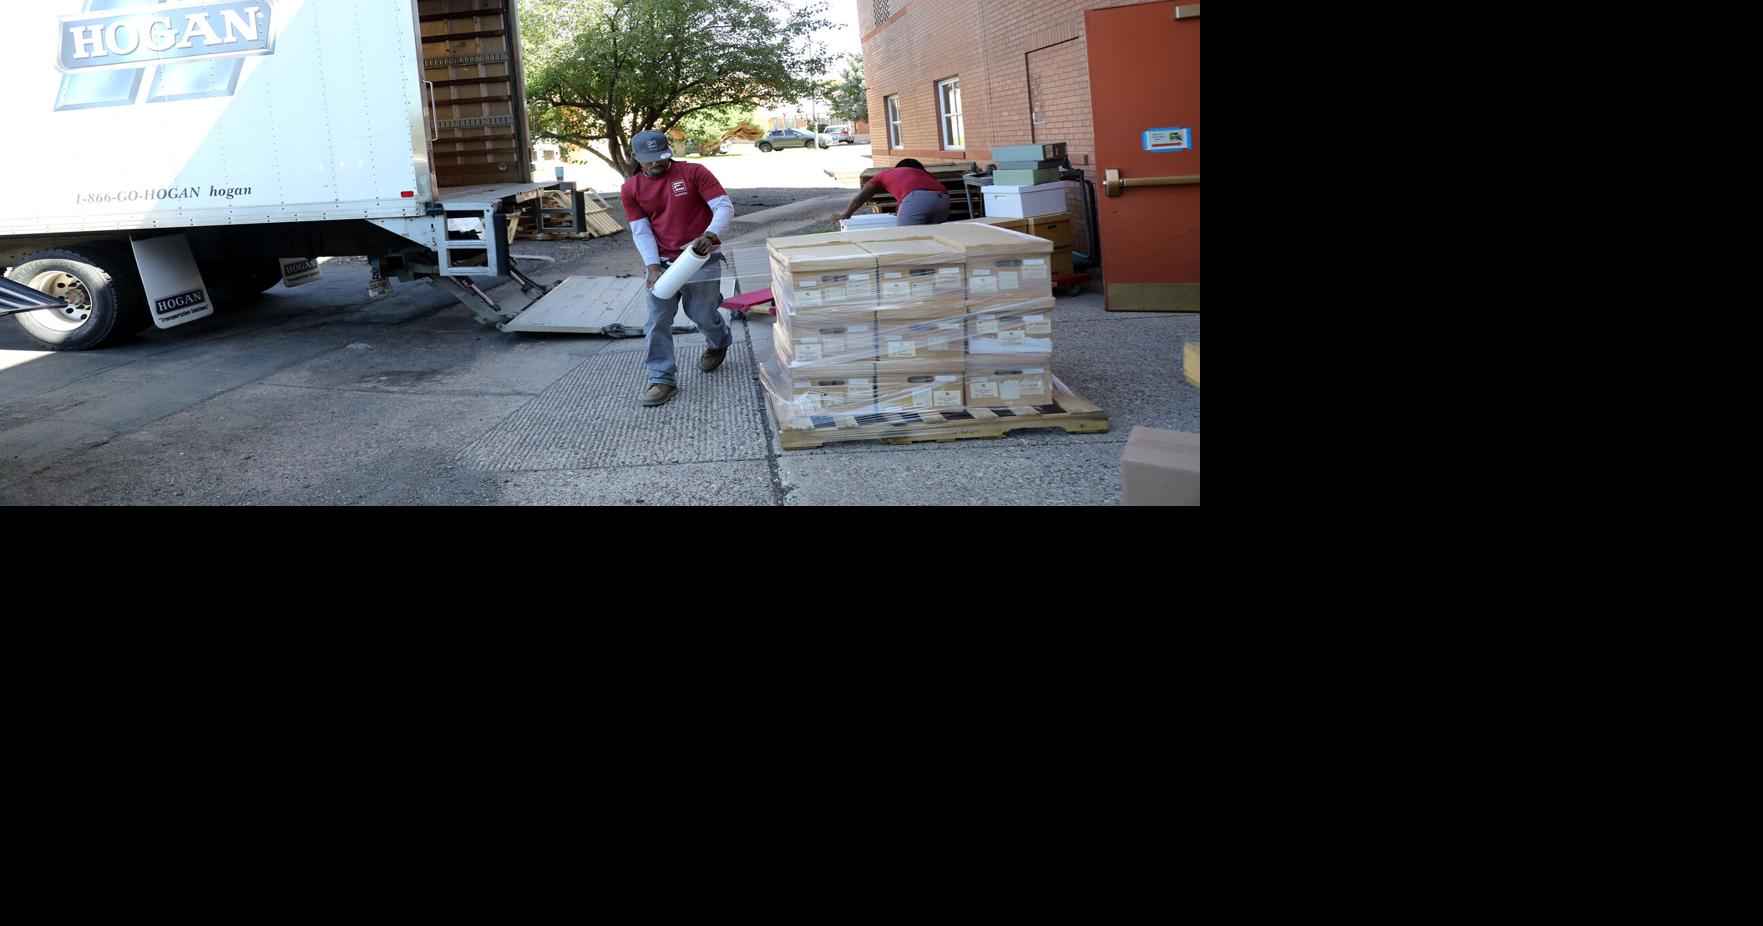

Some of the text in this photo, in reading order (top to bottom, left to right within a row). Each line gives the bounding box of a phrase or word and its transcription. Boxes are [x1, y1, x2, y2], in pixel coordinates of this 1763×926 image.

[69, 6, 260, 60] HOGAN
[76, 185, 252, 205] 1-866-GO-HOGAN hogan
[157, 291, 202, 312] HOGAN
